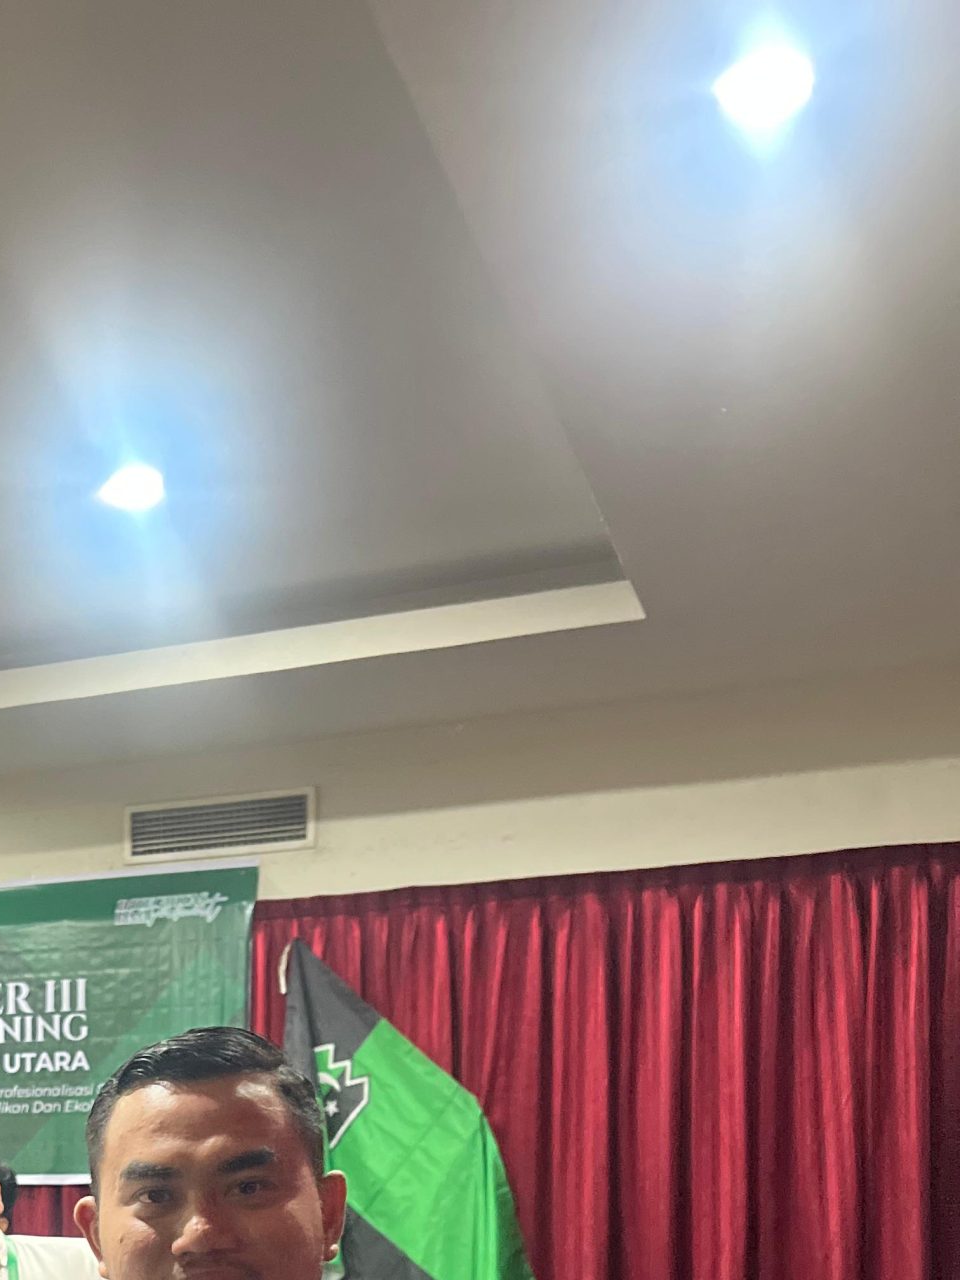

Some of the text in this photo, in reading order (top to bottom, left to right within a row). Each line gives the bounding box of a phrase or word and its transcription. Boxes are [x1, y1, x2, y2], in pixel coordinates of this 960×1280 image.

[44, 978, 87, 1014] III
[3, 1050, 90, 1074] UTARA
[32, 1100, 62, 1113] Dan
[65, 1099, 95, 1113] Eko
